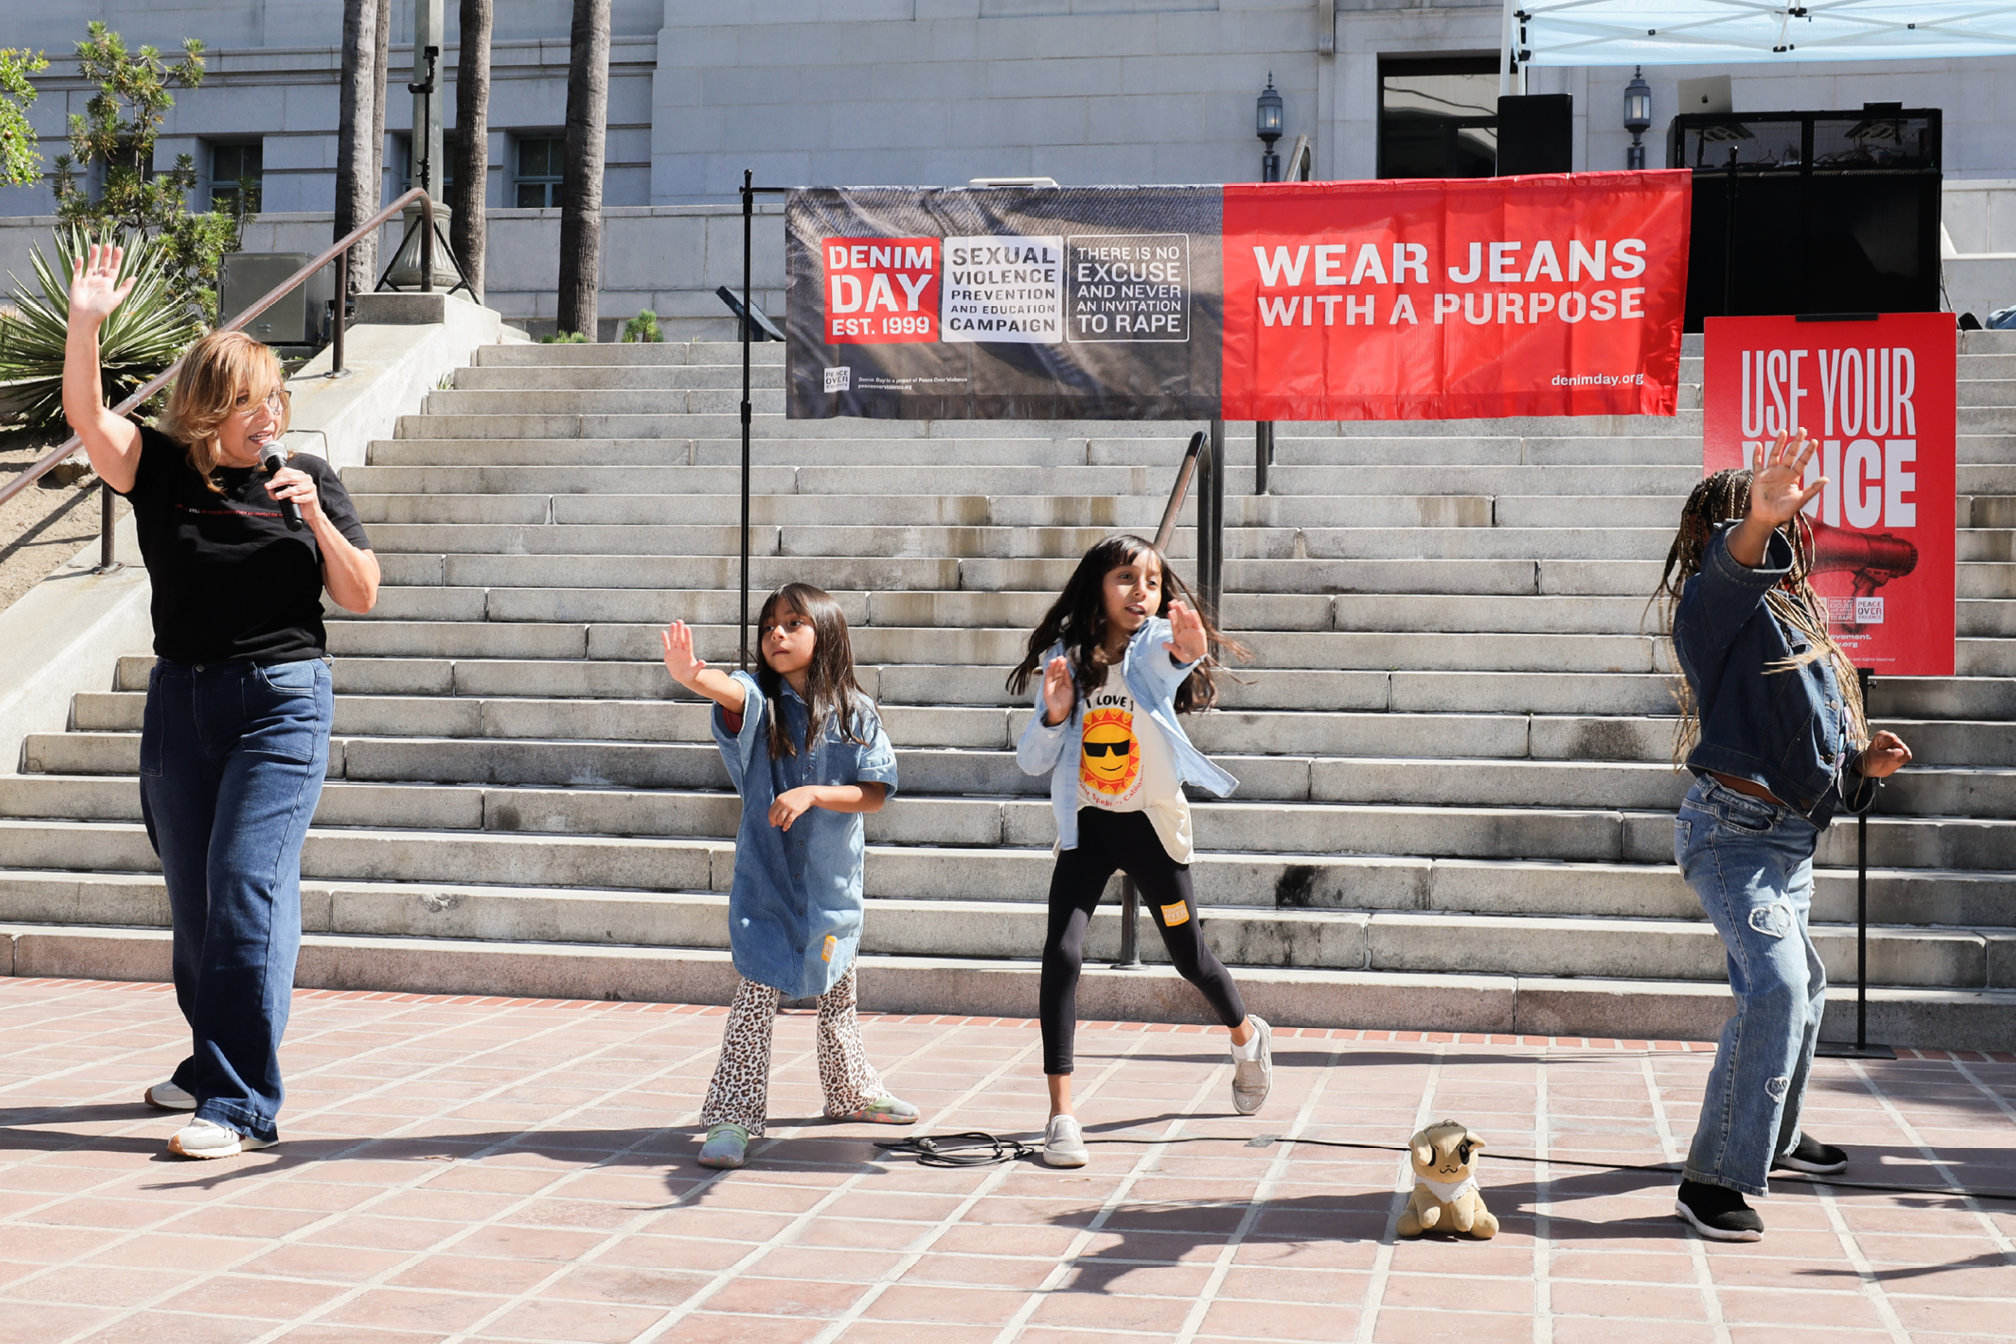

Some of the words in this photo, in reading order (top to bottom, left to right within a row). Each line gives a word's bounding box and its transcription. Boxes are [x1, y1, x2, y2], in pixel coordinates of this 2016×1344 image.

[828, 246, 932, 270] DENIM
[952, 246, 1056, 266] SEXUAL
[1077, 247, 1130, 260] THERE
[1135, 246, 1150, 260] IS
[1155, 246, 1180, 260] NO
[1253, 243, 1428, 286] WEAR
[1448, 238, 1646, 284] JEANS
[952, 268, 1056, 286] VIOLENCE
[1077, 262, 1181, 282] EXCUSE
[831, 273, 933, 314] DAY
[951, 288, 1056, 301] PREVENTION
[1077, 285, 1116, 298] AND
[1120, 284, 1181, 298] NEVER
[951, 304, 978, 314] AND
[982, 304, 1056, 314] EDUCATION
[1077, 300, 1097, 311] AN
[1100, 300, 1181, 311] INVITATION
[1258, 294, 1374, 326] WITH
[1388, 294, 1418, 325] A
[1434, 287, 1645, 325] PURPOSE
[832, 318, 876, 336] EST.
[882, 316, 930, 335] 1999
[949, 318, 1056, 332] CAMPAIGN
[1078, 314, 1108, 332] TO
[1115, 314, 1181, 332] RAPE
[826, 376, 848, 384] OVER
[1551, 372, 1644, 386] denimday.org
[1742, 349, 1808, 438] USE
[1818, 348, 1916, 437] YOUR
[1085, 698, 1092, 708] I
[1096, 694, 1128, 708] LOVE
[1164, 910, 1186, 919] OVER
